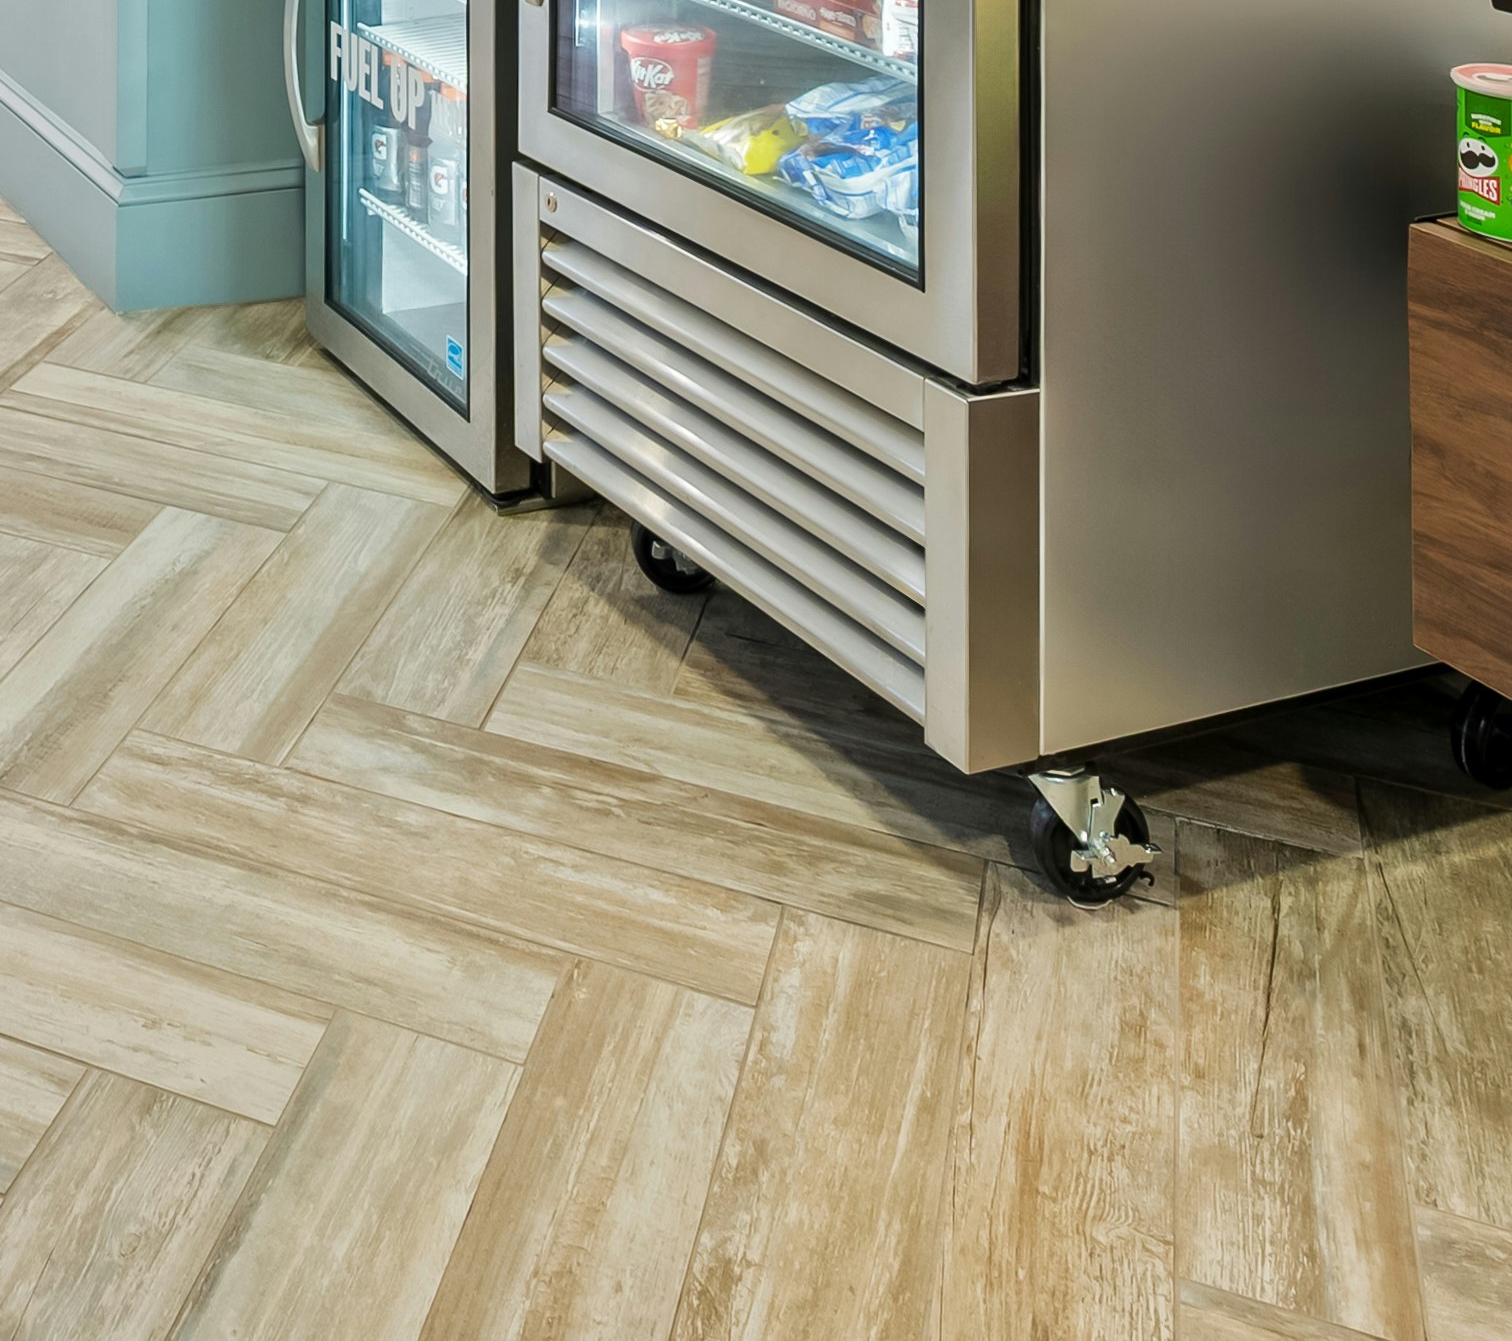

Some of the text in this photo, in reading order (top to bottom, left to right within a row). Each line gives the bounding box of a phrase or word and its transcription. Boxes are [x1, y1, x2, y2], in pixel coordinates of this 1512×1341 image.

[331, 21, 425, 130] FUEL UP
[1472, 122, 1502, 134] FLAVOR
[1459, 177, 1499, 203] PRINGLES
